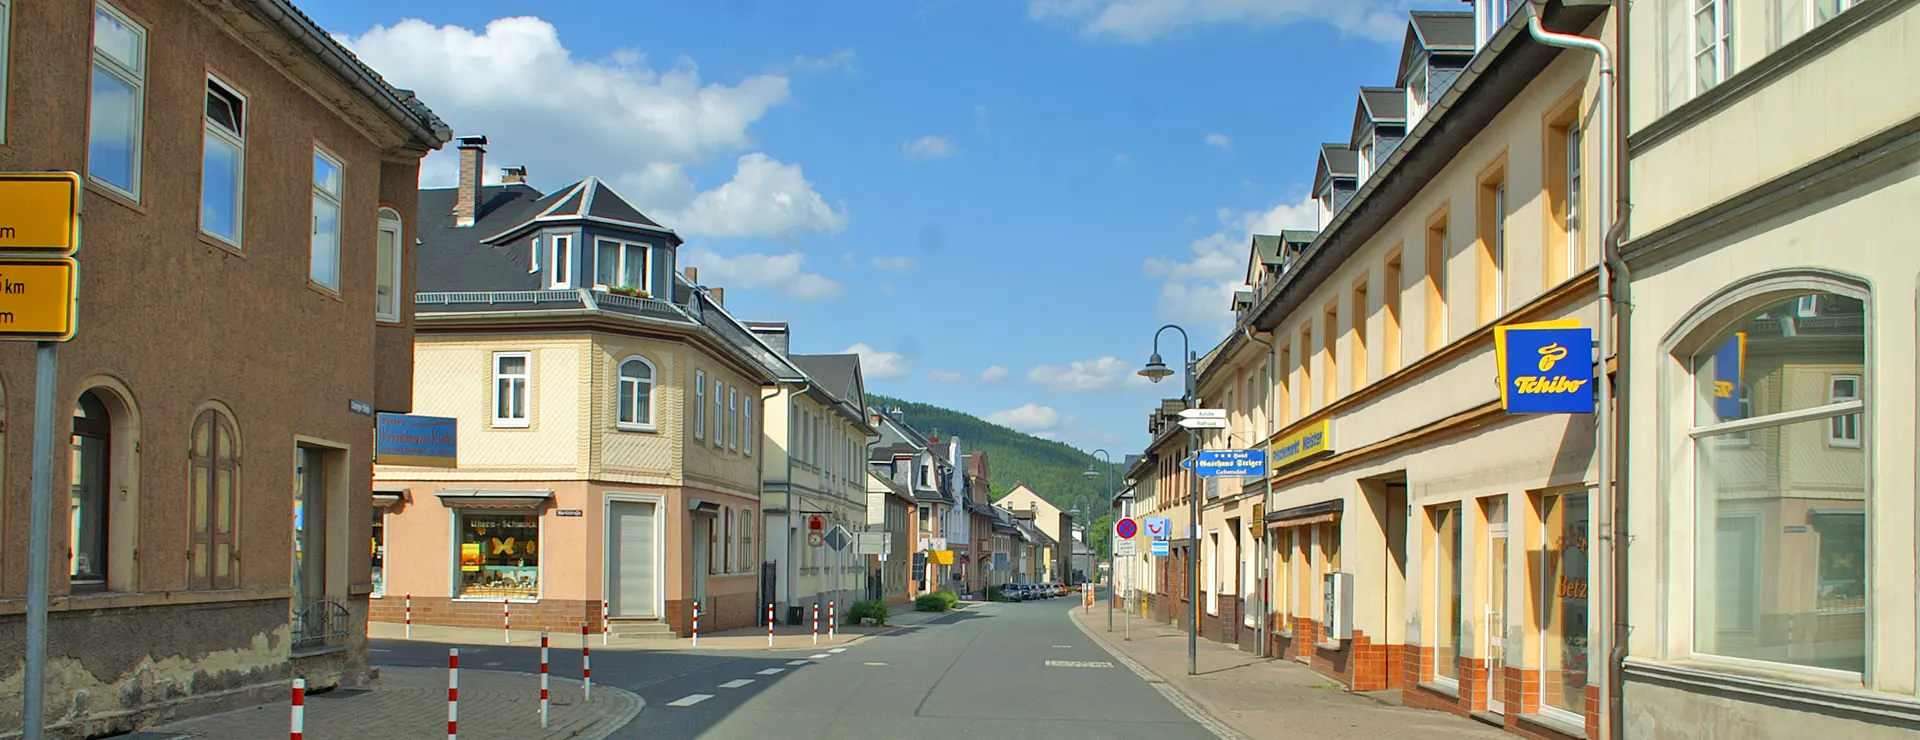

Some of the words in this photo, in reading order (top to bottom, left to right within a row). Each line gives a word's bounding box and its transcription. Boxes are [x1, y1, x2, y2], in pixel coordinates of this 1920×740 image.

[5, 278, 25, 294] km
[1513, 375, 1588, 394] Tchibo
[1199, 459, 1234, 468] Gasthaus
[1557, 575, 1588, 599] Betz
